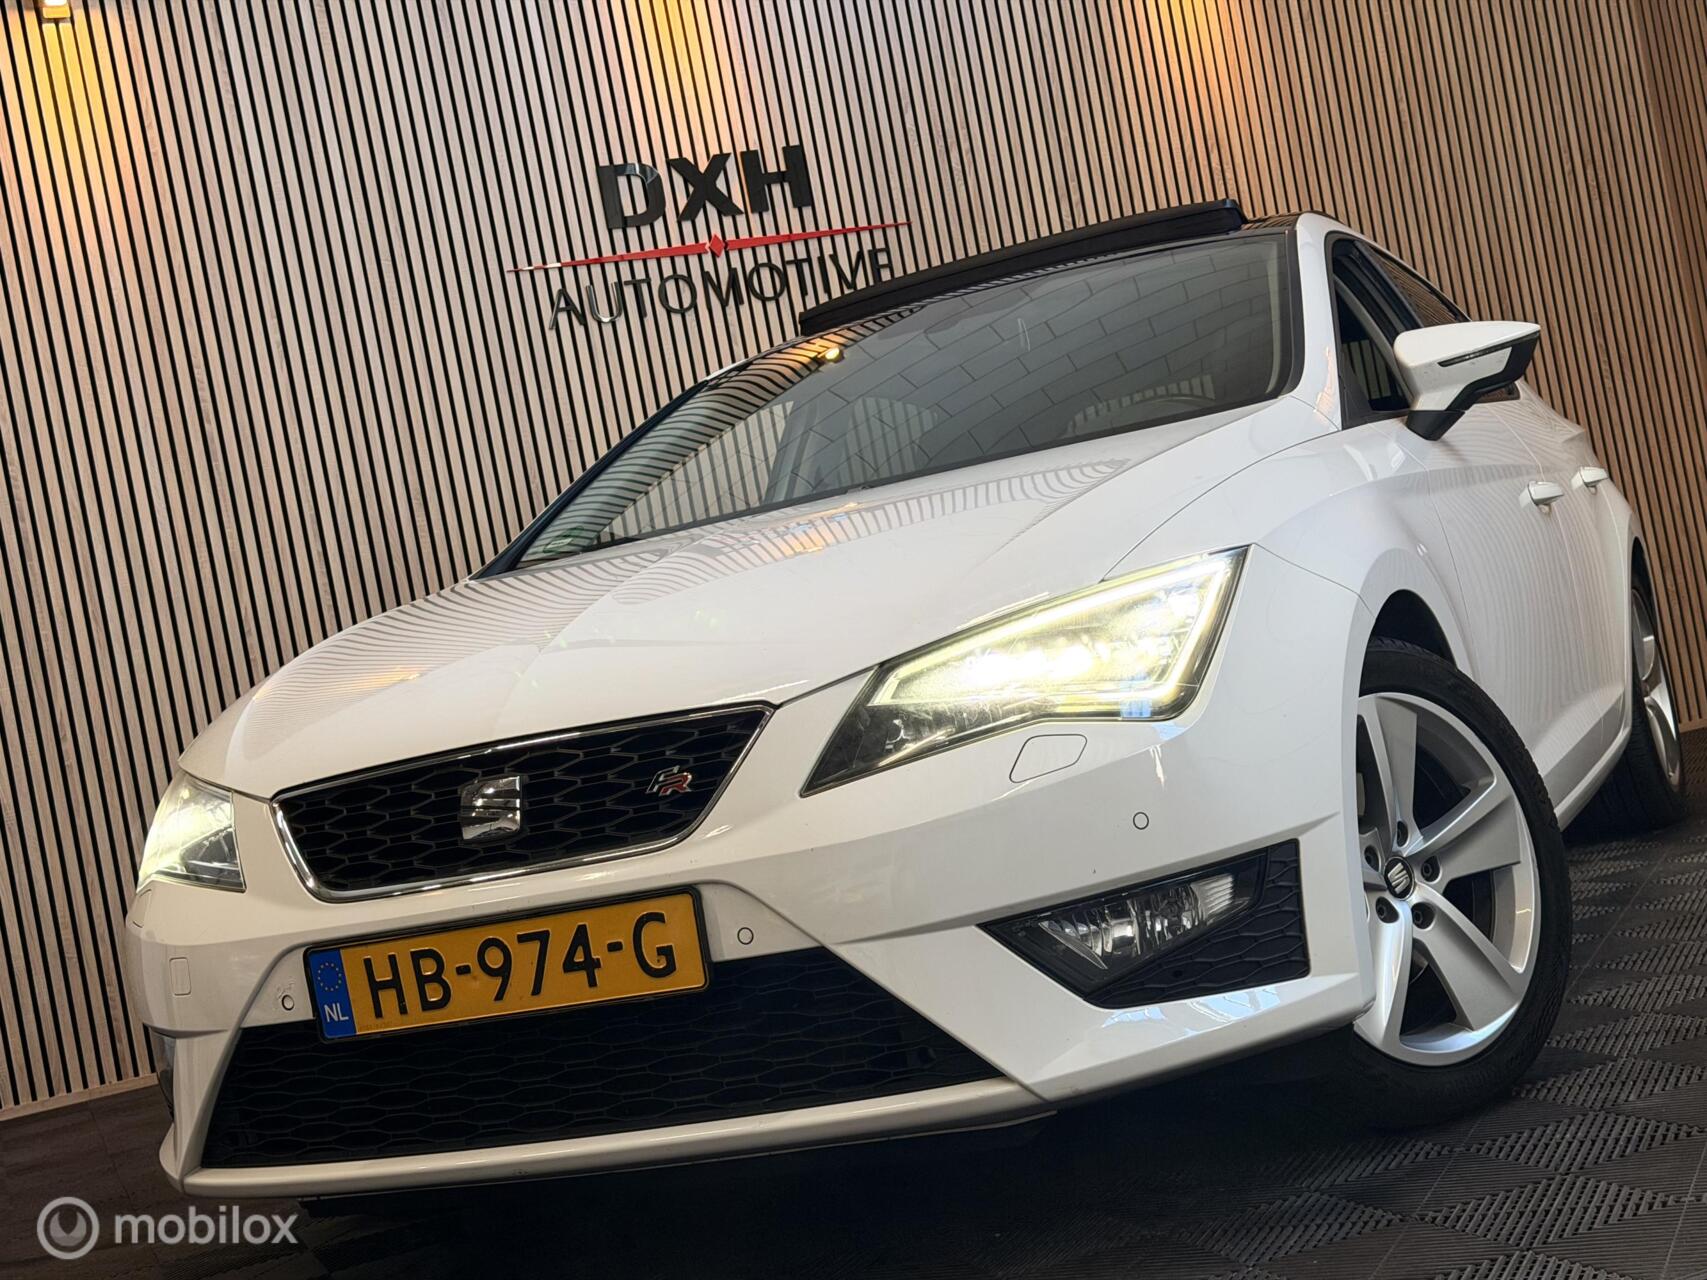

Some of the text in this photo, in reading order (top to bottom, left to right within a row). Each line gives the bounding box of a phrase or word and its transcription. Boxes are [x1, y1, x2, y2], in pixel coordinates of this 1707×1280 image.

[599, 144, 812, 230] DXH
[548, 246, 893, 330] AUTOMOTIVE
[363, 911, 678, 1019] HB-974-G
[323, 1002, 349, 1023] NL
